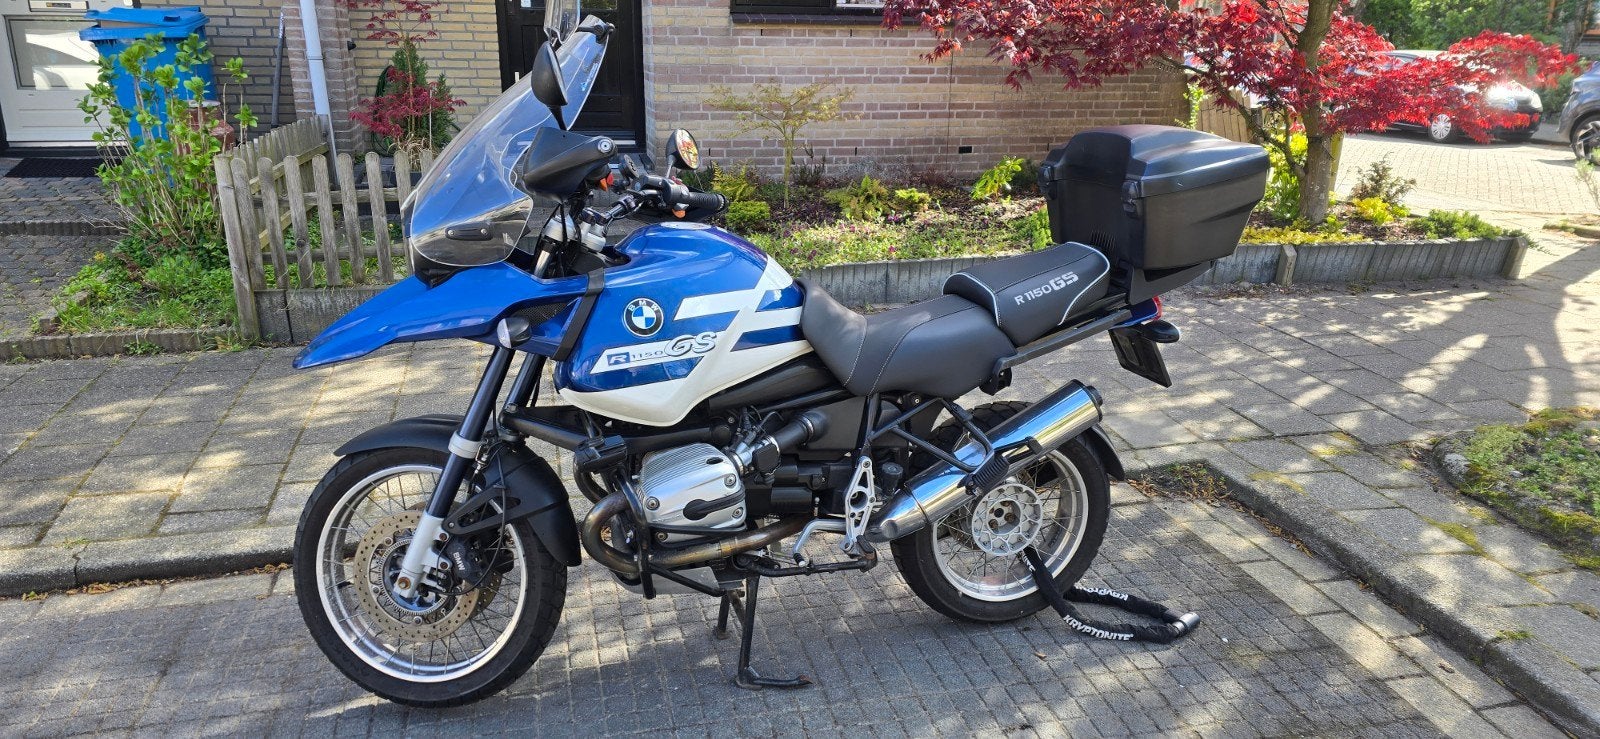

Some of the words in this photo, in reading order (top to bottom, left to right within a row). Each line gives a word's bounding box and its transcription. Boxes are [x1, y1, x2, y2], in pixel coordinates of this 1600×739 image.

[627, 299, 659, 312] BMW
[453, 551, 465, 570] BMW
[1063, 614, 1134, 641] KRYPTONITE
